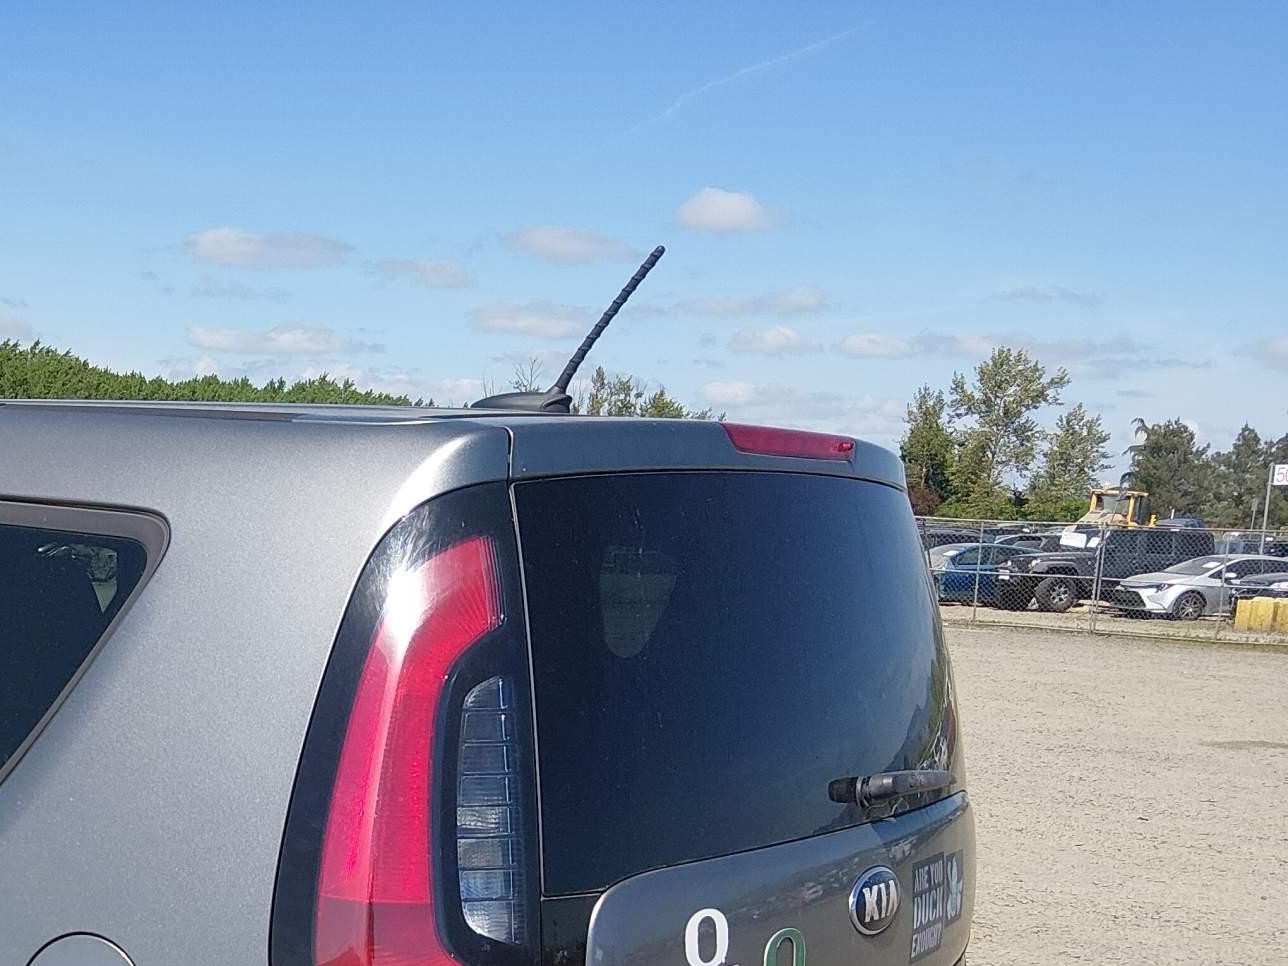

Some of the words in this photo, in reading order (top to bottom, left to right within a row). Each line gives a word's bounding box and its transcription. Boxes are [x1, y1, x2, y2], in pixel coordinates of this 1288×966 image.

[1276, 467, 1288, 482] 5
[914, 865, 929, 894] ARE
[929, 859, 944, 887] YOU
[863, 879, 899, 924] KIA
[913, 885, 944, 930] DUCK
